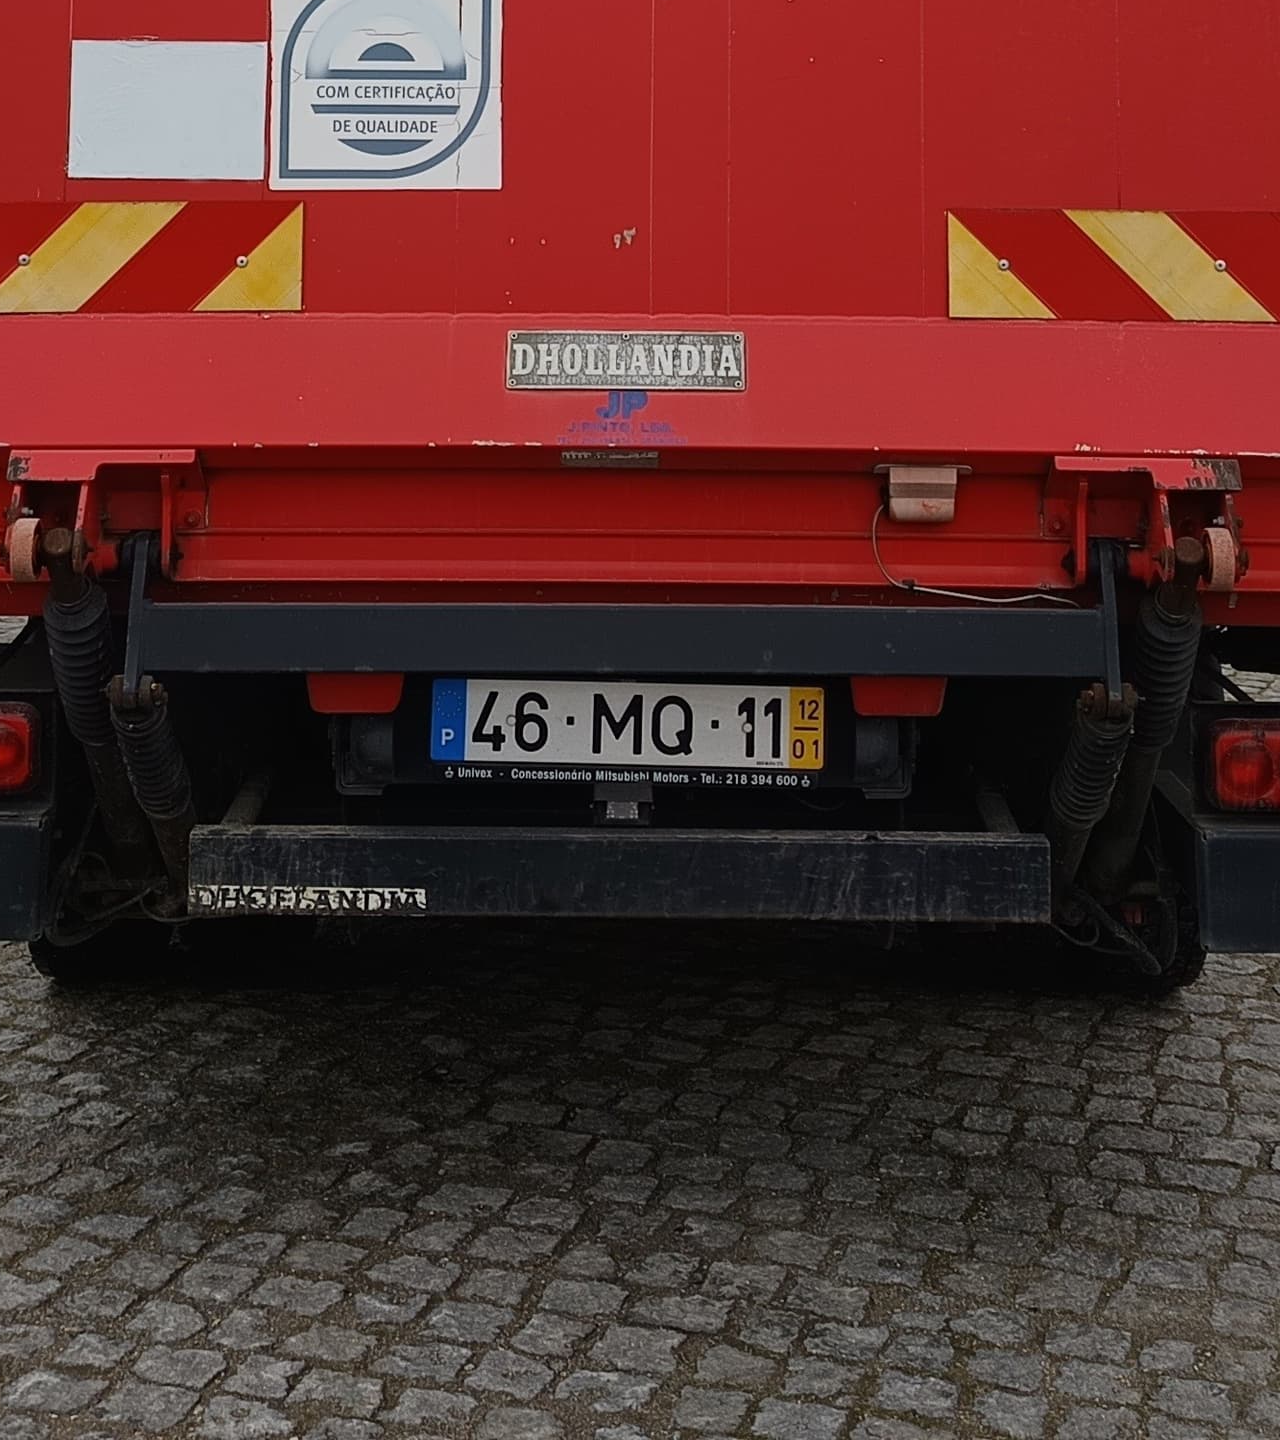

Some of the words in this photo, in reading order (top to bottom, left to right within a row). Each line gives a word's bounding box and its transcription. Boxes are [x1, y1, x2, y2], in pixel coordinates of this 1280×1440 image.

[316, 85, 350, 99] COM
[354, 83, 456, 102] CERTIFICAÇÃO
[332, 119, 352, 133] DE
[355, 119, 438, 135] QUALIDADE
[511, 343, 740, 377] DHOLLANDIA
[596, 391, 648, 419] JP
[799, 699, 819, 721] 12
[441, 728, 454, 746] P
[458, 767, 493, 779] Univex
[511, 768, 592, 781] Concessionário
[595, 770, 650, 783] Mitsubishi
[653, 771, 689, 783] Motors
[701, 773, 722, 785] Tel.:
[726, 773, 748, 785] 218
[751, 774, 772, 786] 394
[776, 775, 798, 786] 600
